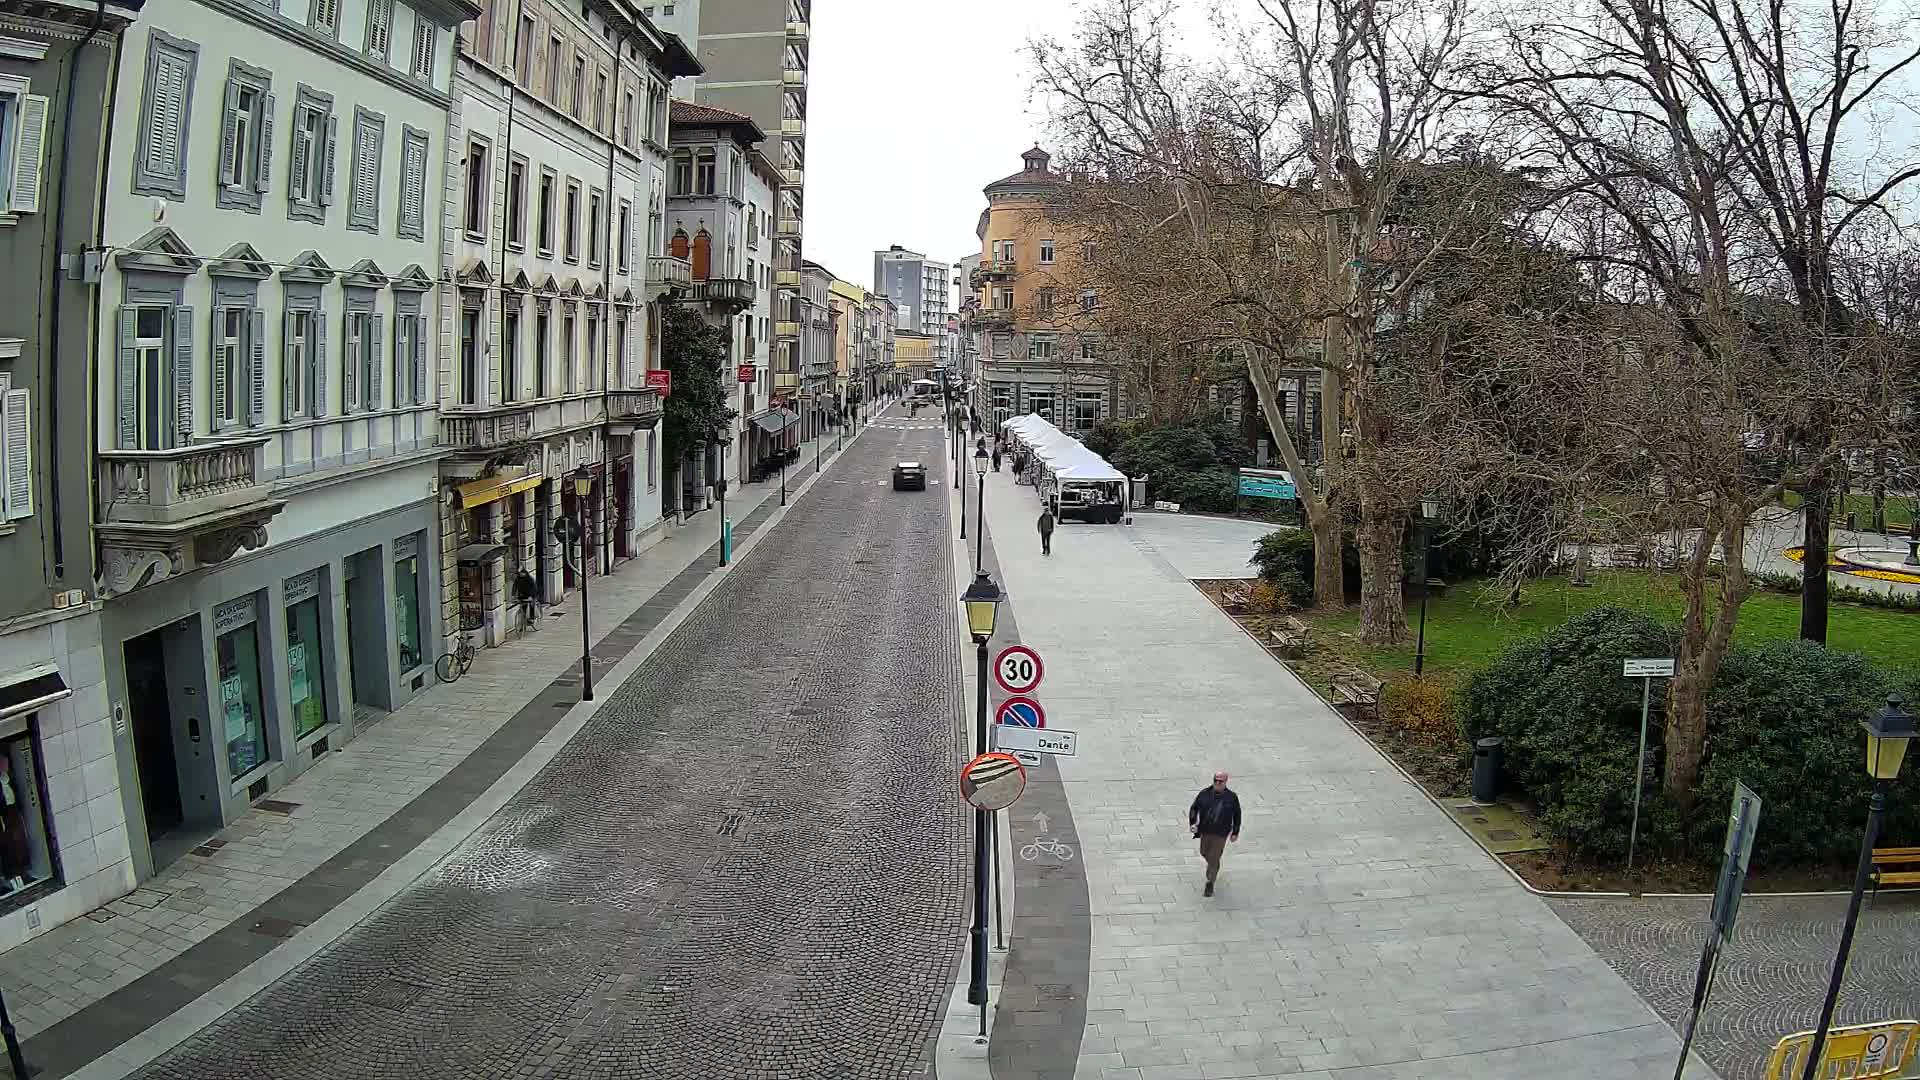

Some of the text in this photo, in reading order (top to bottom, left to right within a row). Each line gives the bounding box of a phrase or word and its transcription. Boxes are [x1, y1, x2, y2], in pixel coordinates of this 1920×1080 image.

[1006, 659, 1033, 681] 30
[223, 678, 240, 701] 130
[1038, 739, 1069, 749] Dante
